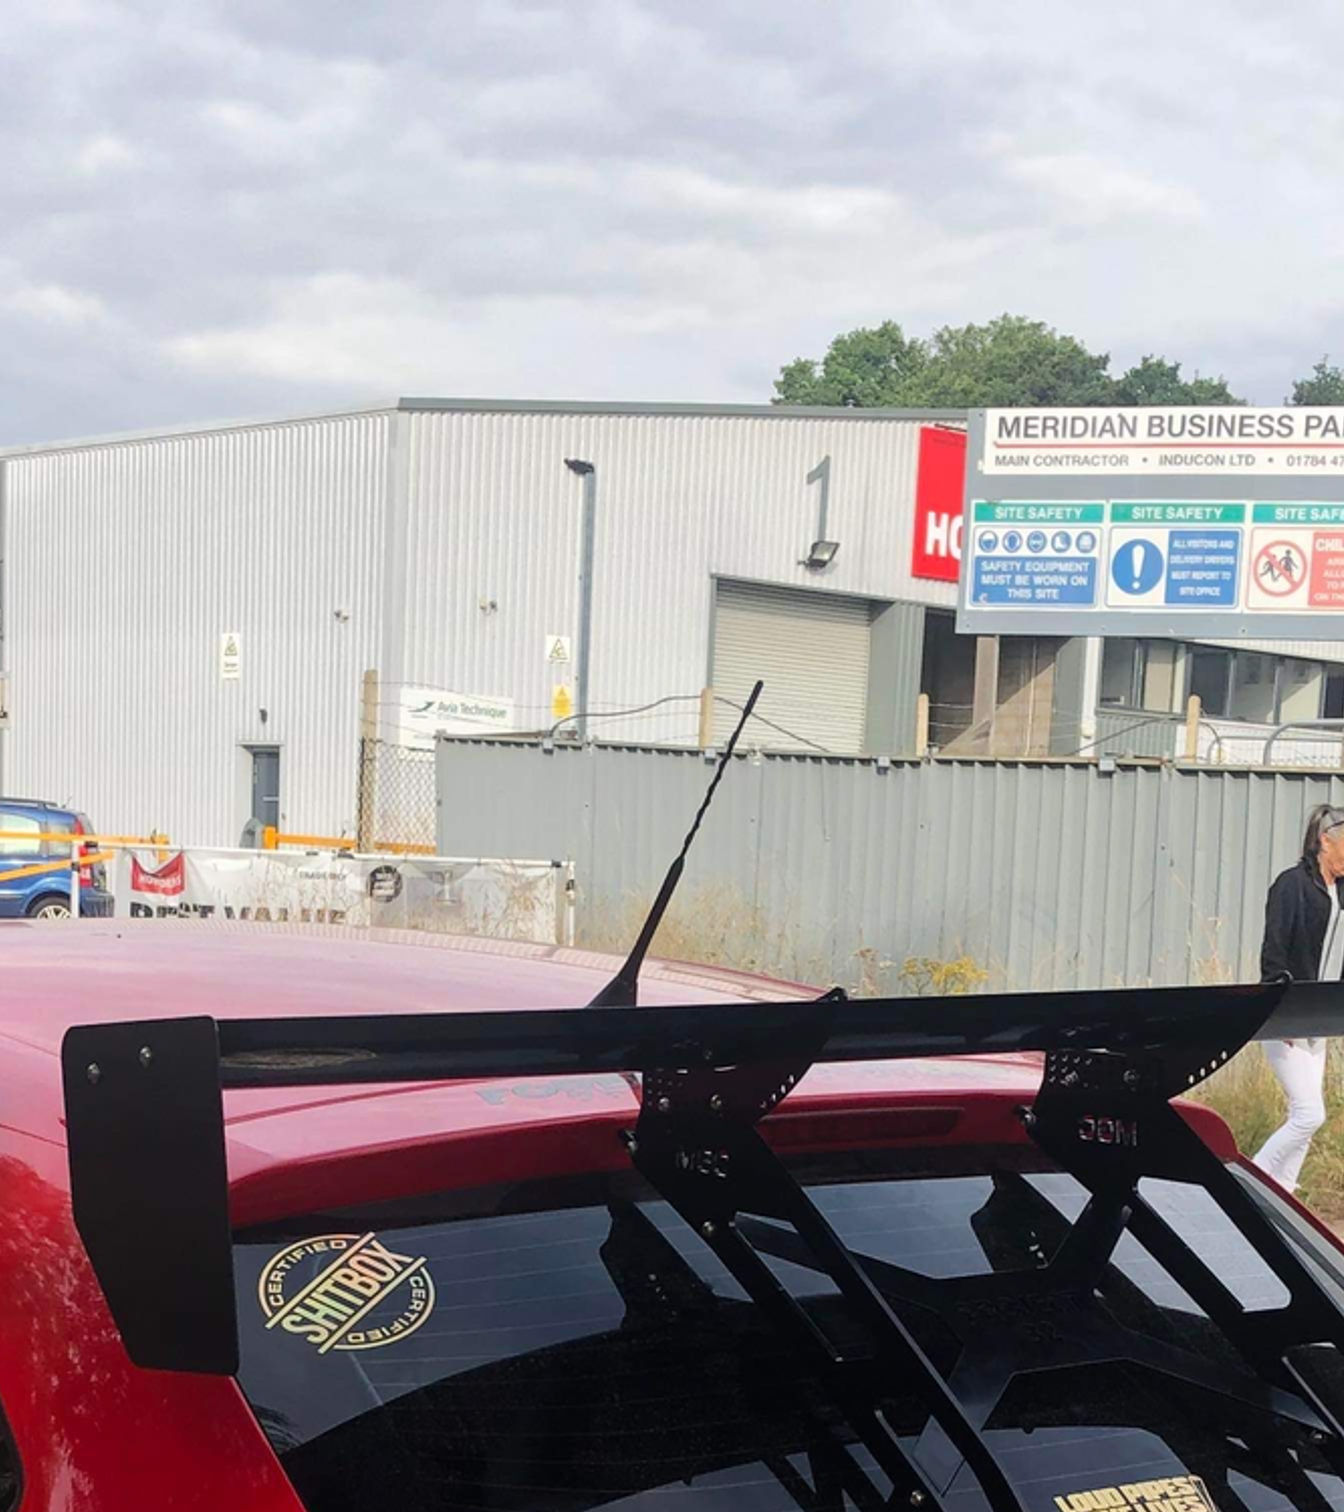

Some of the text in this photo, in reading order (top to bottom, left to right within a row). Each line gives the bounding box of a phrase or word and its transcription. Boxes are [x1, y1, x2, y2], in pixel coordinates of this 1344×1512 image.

[998, 414, 1137, 439] MERIDIAN
[1147, 414, 1294, 439] BUSINESS
[994, 455, 1029, 467] MAIN
[1033, 454, 1129, 467] CONTRACTOR
[1159, 454, 1225, 466] INDUCON
[1230, 454, 1256, 466] LTD
[1286, 455, 1327, 467] 01784
[994, 506, 1084, 520] SITE SAFETY
[1131, 506, 1223, 520] SITE SAFETY
[1274, 508, 1306, 521] SITE
[980, 561, 1090, 572] SAFETY EQUIPMENT
[980, 575, 1088, 585] MUST BE WORN ON
[1007, 588, 1060, 599] THIS SITE
[460, 702, 507, 719] Technique
[268, 1239, 347, 1306] CERTIFIED
[281, 1239, 414, 1344] SHITBOX
[347, 1275, 427, 1343] CERTIFIED
[1118, 1476, 1197, 1503] PIPES
